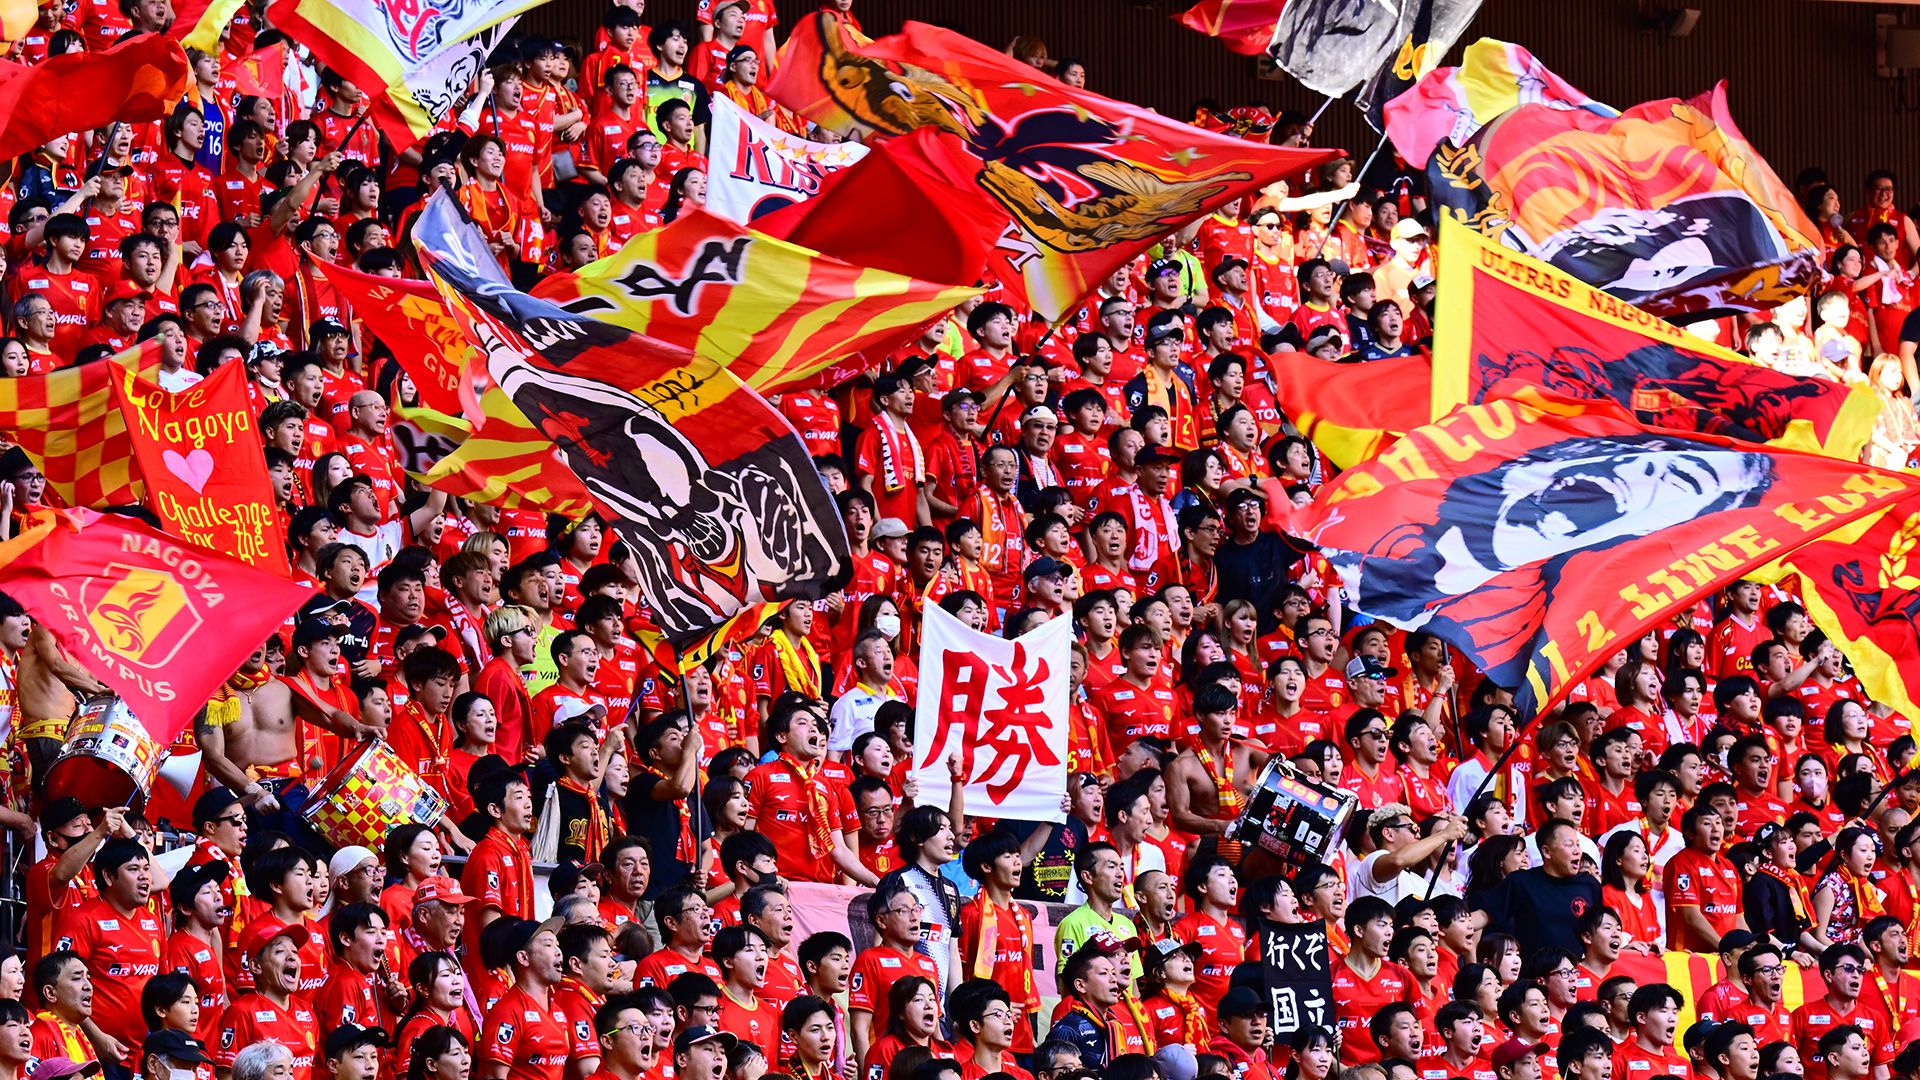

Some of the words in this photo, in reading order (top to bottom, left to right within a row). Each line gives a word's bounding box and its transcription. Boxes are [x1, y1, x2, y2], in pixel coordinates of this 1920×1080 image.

[209, 135, 222, 155] 16
[1480, 246, 1572, 299] ULTRAS
[1588, 289, 1687, 338] NAGOYA
[54, 313, 87, 325] YARIS
[123, 368, 206, 414] Love
[136, 404, 249, 449] Nagoya
[1066, 477, 1083, 487] GR
[158, 491, 273, 535] Challenge
[179, 521, 215, 550] for
[233, 520, 270, 557] the
[507, 527, 526, 538] GR
[982, 542, 1001, 566] 12
[121, 533, 225, 609] NAGOYA
[1618, 523, 1782, 621] LINE
[50, 582, 177, 702] GRAMPUS
[920, 641, 1062, 806] 勝
[1126, 727, 1143, 736] GR
[776, 811, 797, 823] GR
[919, 929, 941, 942] GR
[1266, 929, 1326, 971] 行くぞ
[108, 966, 130, 976] GR
[1202, 967, 1222, 976] GR
[1271, 986, 1334, 1036] 国立
[1338, 1018, 1357, 1028] GR
